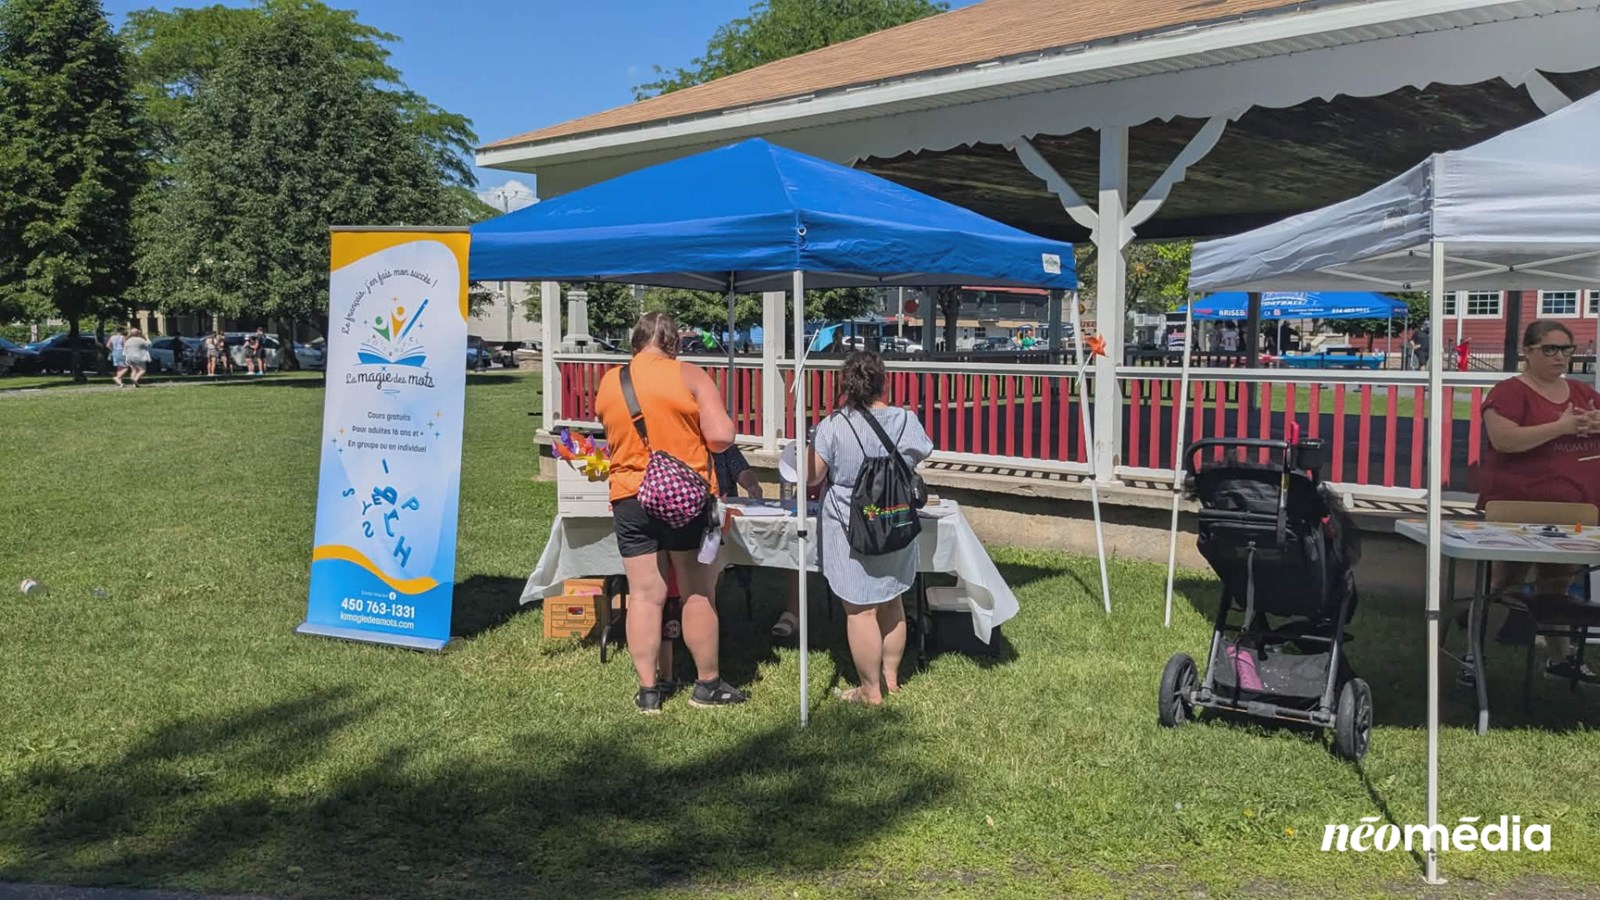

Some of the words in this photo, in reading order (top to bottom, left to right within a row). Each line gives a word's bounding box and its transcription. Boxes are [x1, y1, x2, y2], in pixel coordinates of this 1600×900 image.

[341, 322, 351, 334] Le
[377, 269, 392, 286] fais
[346, 373, 357, 384] La
[357, 372, 393, 390] magie
[393, 373, 407, 384] des
[408, 371, 435, 388] mots
[367, 411, 386, 419] Cours
[386, 413, 411, 421] gratuits
[352, 425, 367, 433] Pour
[368, 426, 391, 435] adultes
[392, 428, 398, 436] 16
[347, 440, 356, 448] En
[357, 441, 379, 450] groupe
[397, 443, 427, 453] individuel
[341, 597, 363, 611] 450
[366, 600, 415, 619] 763-1331
[340, 611, 415, 630] lamagiedesmots.com
